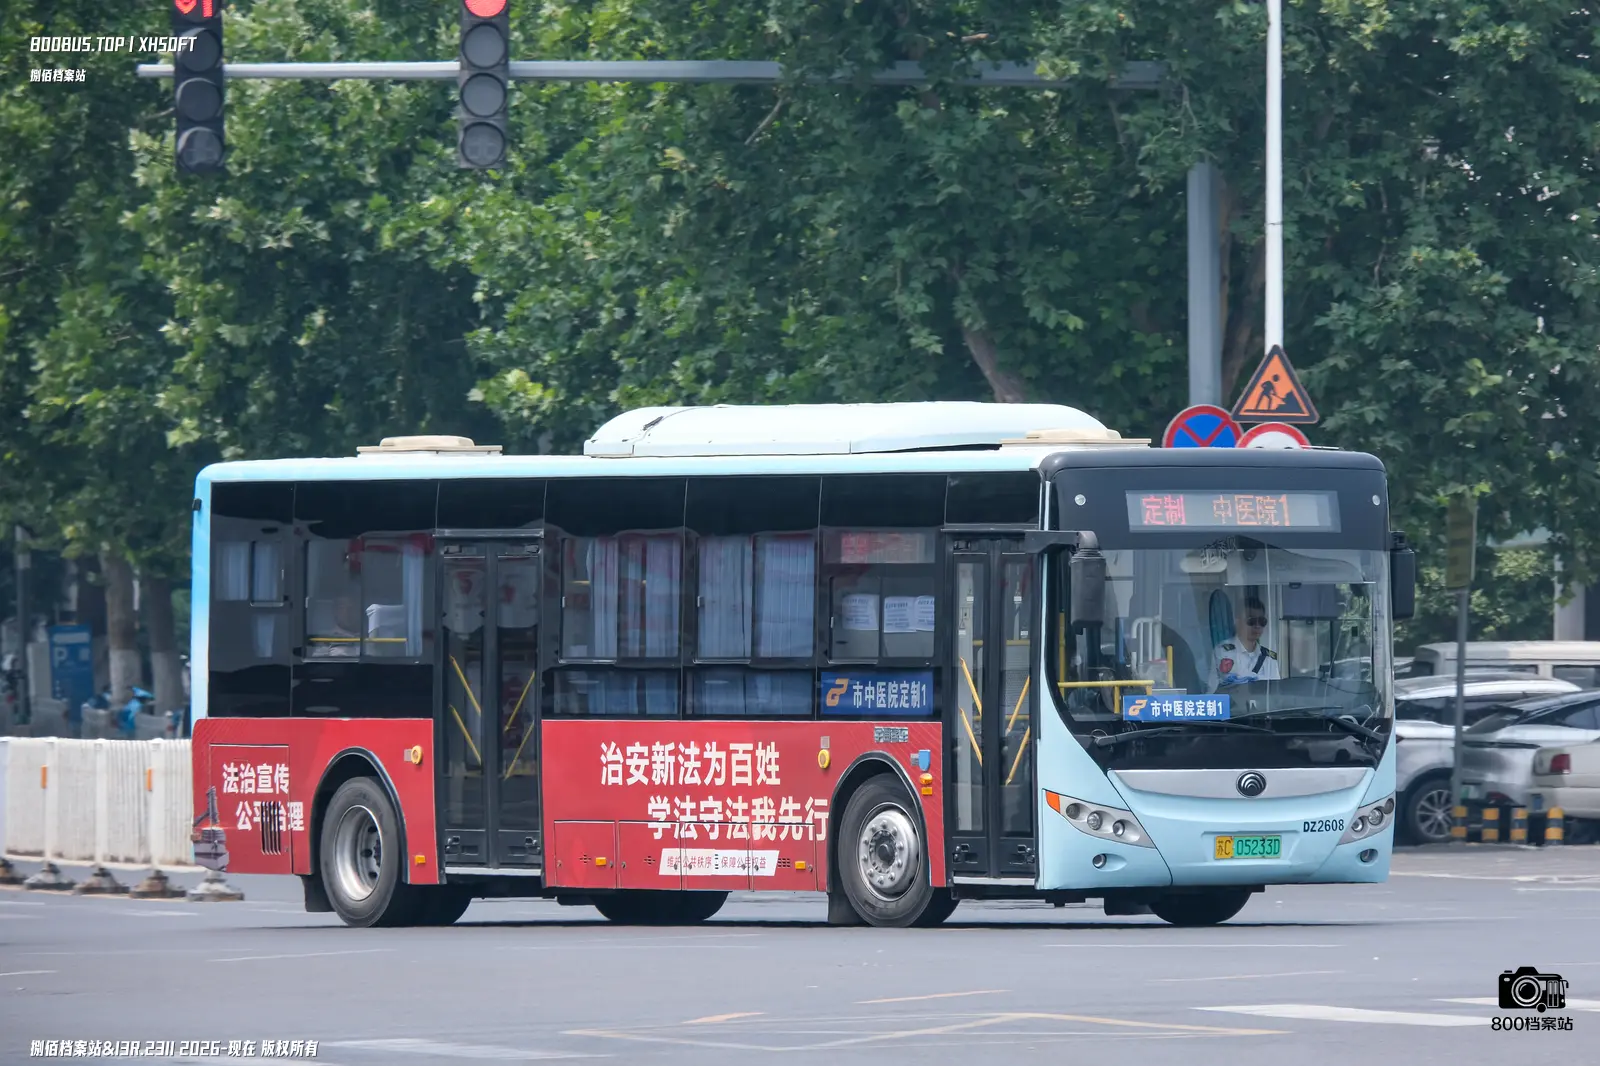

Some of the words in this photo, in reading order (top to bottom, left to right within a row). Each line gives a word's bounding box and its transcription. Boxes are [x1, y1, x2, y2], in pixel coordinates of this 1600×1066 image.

[1141, 494, 1186, 526] 定制
[1212, 494, 1291, 526] 中医院1
[852, 680, 927, 709] 市中医院定制1
[1150, 700, 1223, 718] 市中医院定制1
[222, 762, 290, 794] 法治宣传
[600, 741, 780, 787] 治安新法为百姓
[647, 795, 829, 841] 学法守法我先行
[1303, 819, 1345, 833] DZ2608
